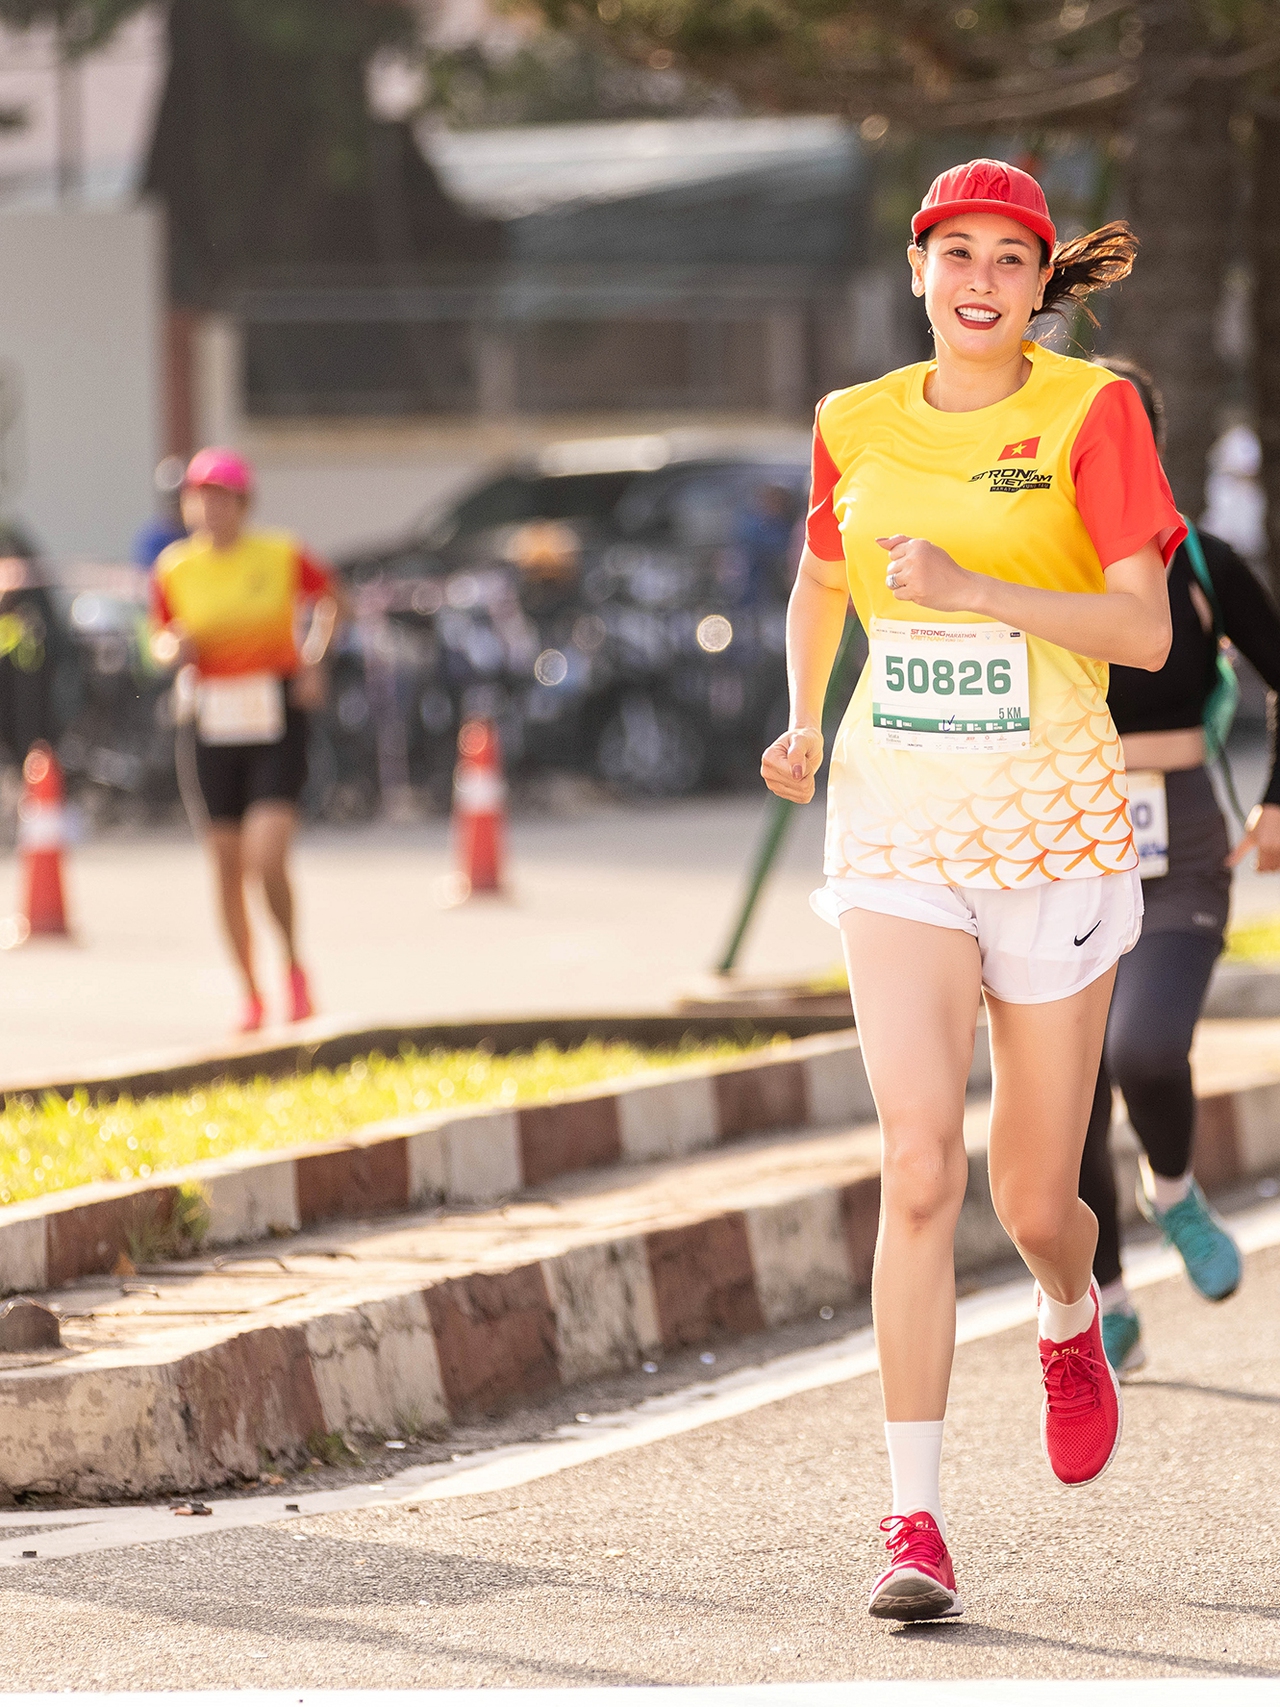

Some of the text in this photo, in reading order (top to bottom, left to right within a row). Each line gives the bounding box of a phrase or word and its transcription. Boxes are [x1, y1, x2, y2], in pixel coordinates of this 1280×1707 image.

[993, 474, 1053, 487] VIETAM
[910, 628, 946, 637] STRONG
[885, 655, 1012, 696] 50826
[998, 706, 1022, 720] 5 KM
